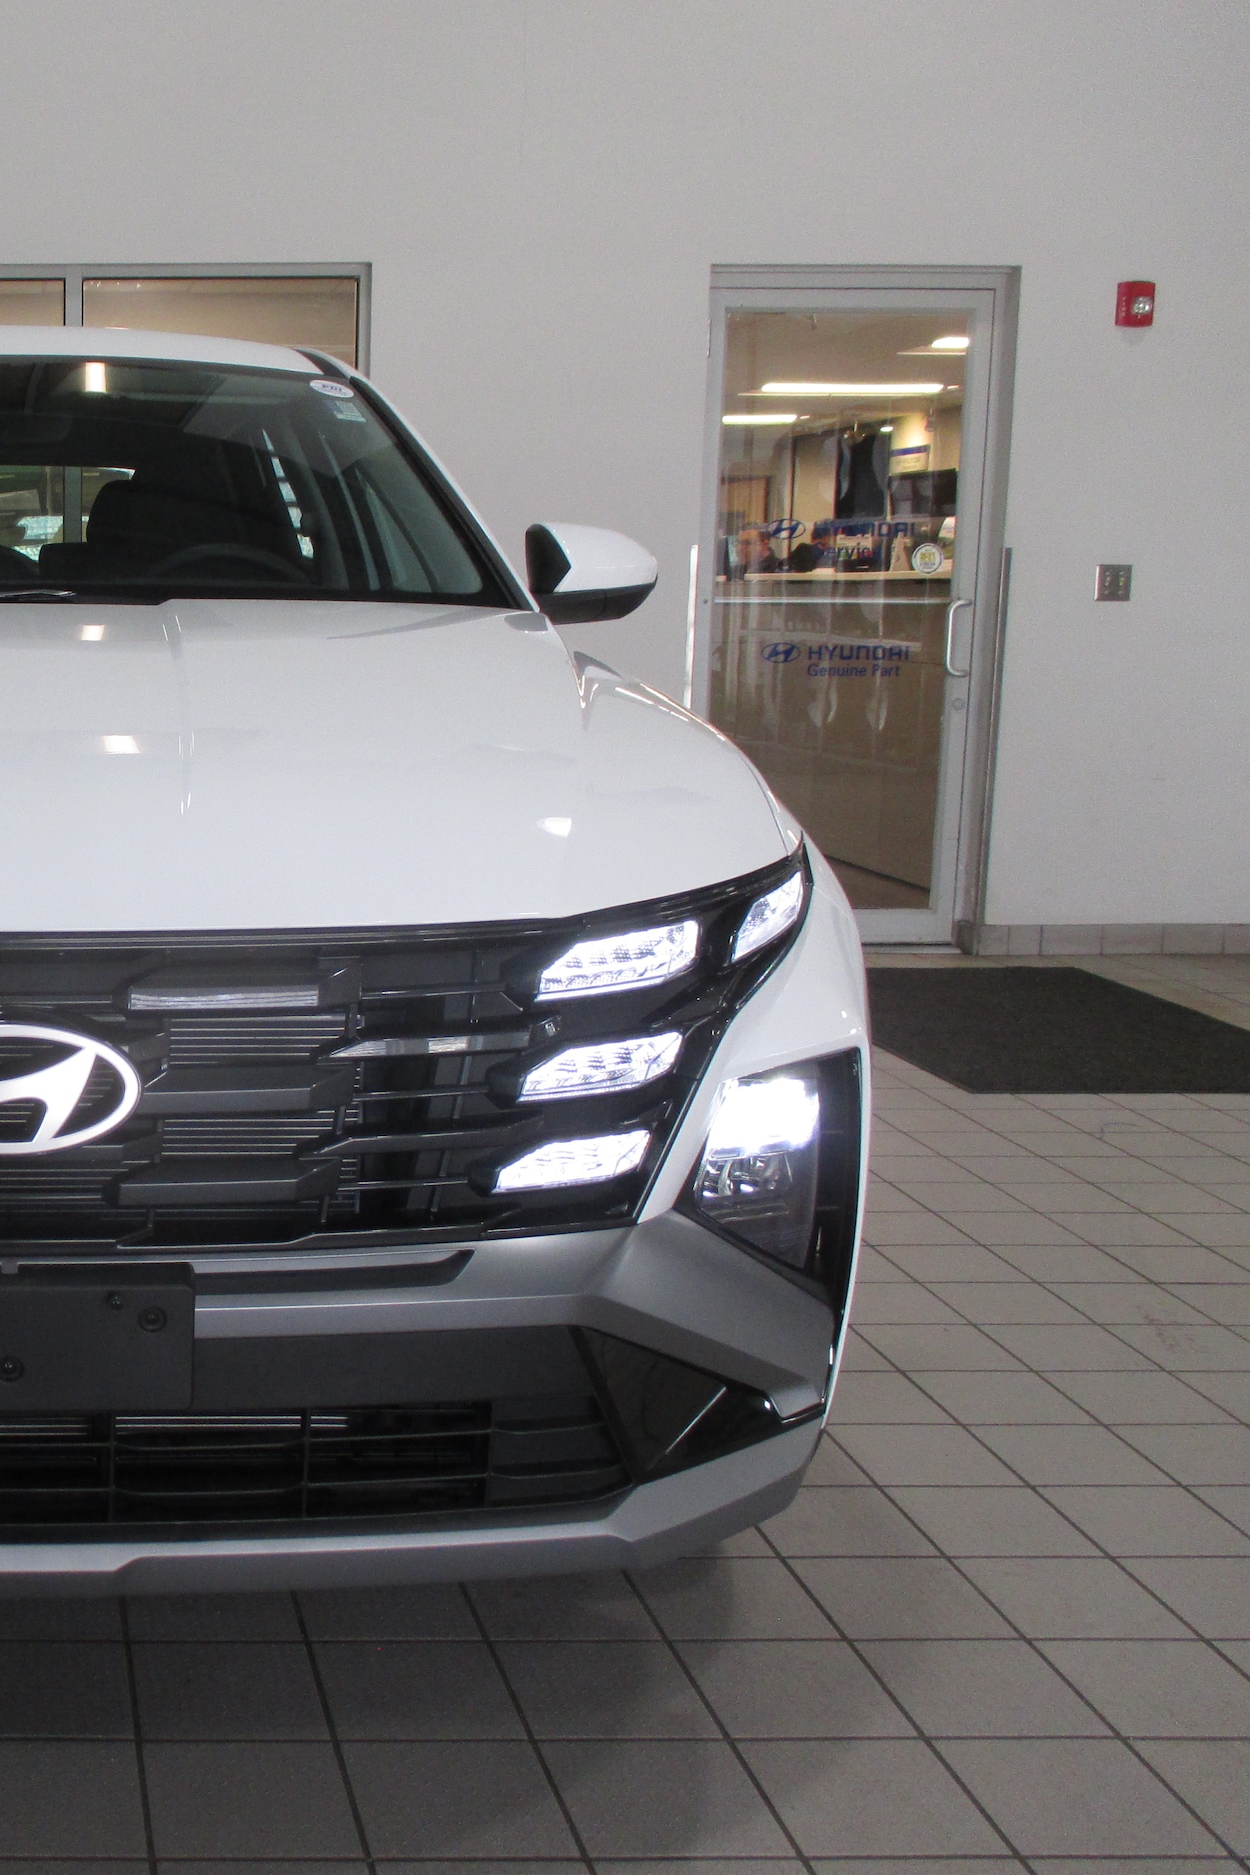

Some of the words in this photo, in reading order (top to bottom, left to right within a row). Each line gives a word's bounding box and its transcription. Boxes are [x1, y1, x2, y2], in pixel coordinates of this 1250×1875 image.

[808, 644, 910, 661] HYUNDAI
[807, 663, 867, 677] Genuine
[872, 663, 901, 677] Part
